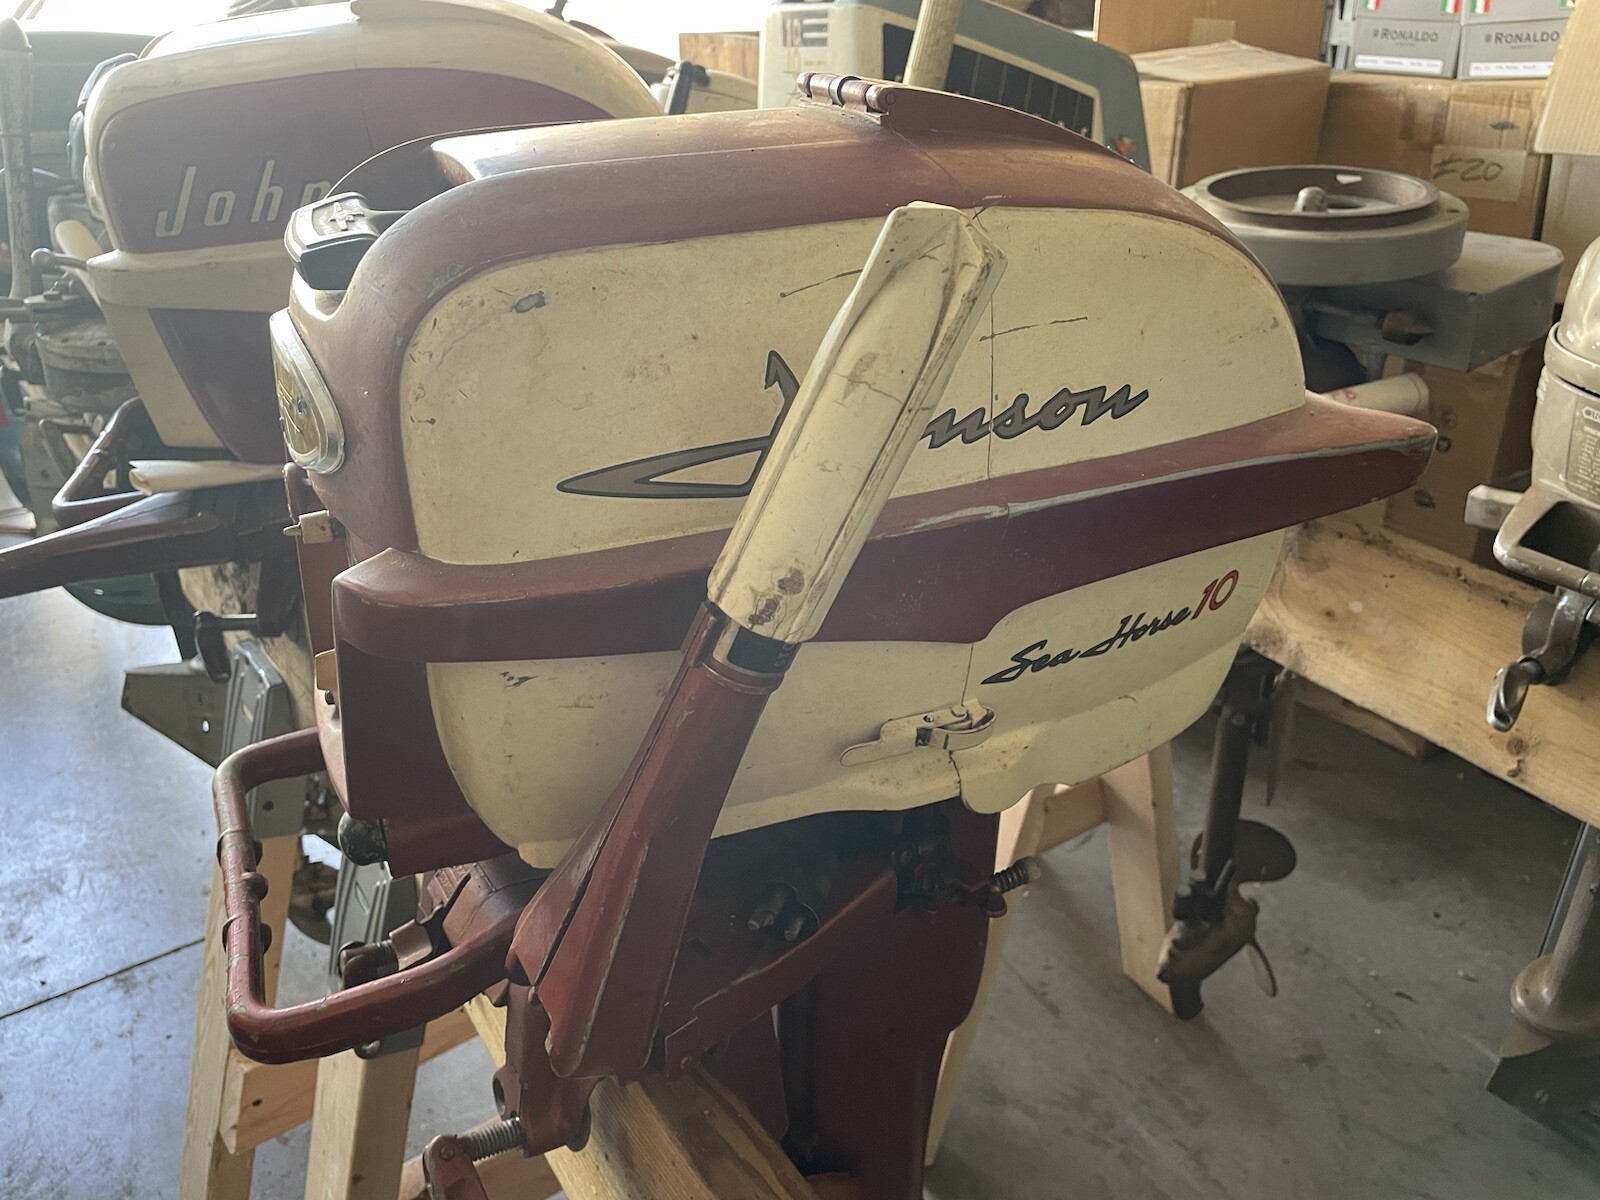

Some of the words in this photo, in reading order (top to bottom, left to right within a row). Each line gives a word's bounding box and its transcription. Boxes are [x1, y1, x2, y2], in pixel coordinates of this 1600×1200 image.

[556, 350, 1150, 499] Jnson
[980, 639, 1081, 685] Sea
[1077, 606, 1192, 659] Horse
[1190, 569, 1240, 621] 10
